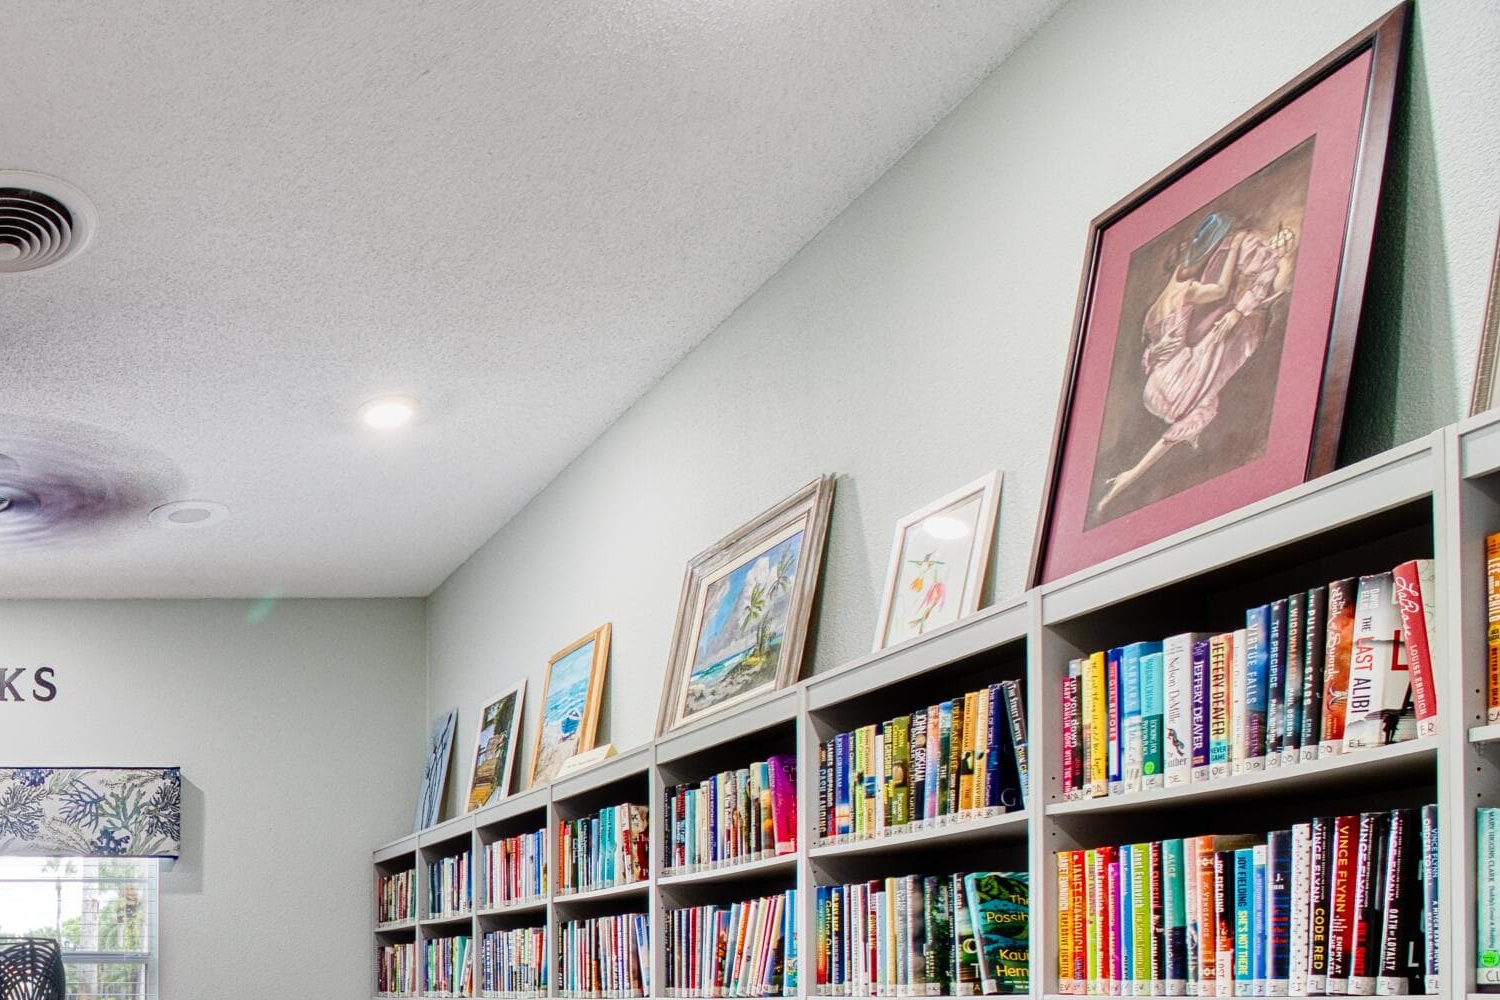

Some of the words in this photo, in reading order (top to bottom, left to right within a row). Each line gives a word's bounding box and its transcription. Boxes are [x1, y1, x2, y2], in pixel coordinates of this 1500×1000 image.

[1361, 616, 1372, 632] THE
[1395, 577, 1419, 638] LaRose
[1247, 623, 1258, 666] VIRTUE
[1355, 636, 1374, 671] LAST
[1410, 644, 1421, 676] LOUISE
[1213, 642, 1224, 689] JEFFERY
[1193, 661, 1204, 706] JEFFERY
[1246, 671, 1257, 705] FALLS
[1351, 678, 1371, 714] ALIBI
[1414, 676, 1427, 715] ERDRICH
[916, 714, 926, 737] JOHN
[1192, 707, 1204, 751] DEAVER
[1212, 691, 1224, 736] DEAVER
[1071, 719, 1080, 748] down
[1313, 823, 1322, 861] VINCE
[1338, 826, 1348, 866] VINCE
[1060, 856, 1069, 879] JANET
[1073, 864, 1082, 893] JANET
[1167, 854, 1176, 877] ALICE
[1238, 857, 1246, 871] JOY
[1060, 880, 1069, 911] EVANOVICH
[1238, 873, 1247, 907] FIELDING
[1336, 870, 1347, 913] FLYNN
[1061, 912, 1069, 946] EXPLOSIVE
[1074, 895, 1083, 953] EVANOVICH
[1238, 910, 1248, 931] SHE'S
[1315, 908, 1324, 940] CODE
[1388, 908, 1399, 929] OATH
[1238, 932, 1248, 952] NOT
[1314, 946, 1324, 970] RED
[1386, 937, 1397, 971] LOYALTY
[1061, 947, 1069, 978] EIGHTEEN
[1238, 953, 1248, 976] THERE
[1335, 963, 1341, 974] AT
